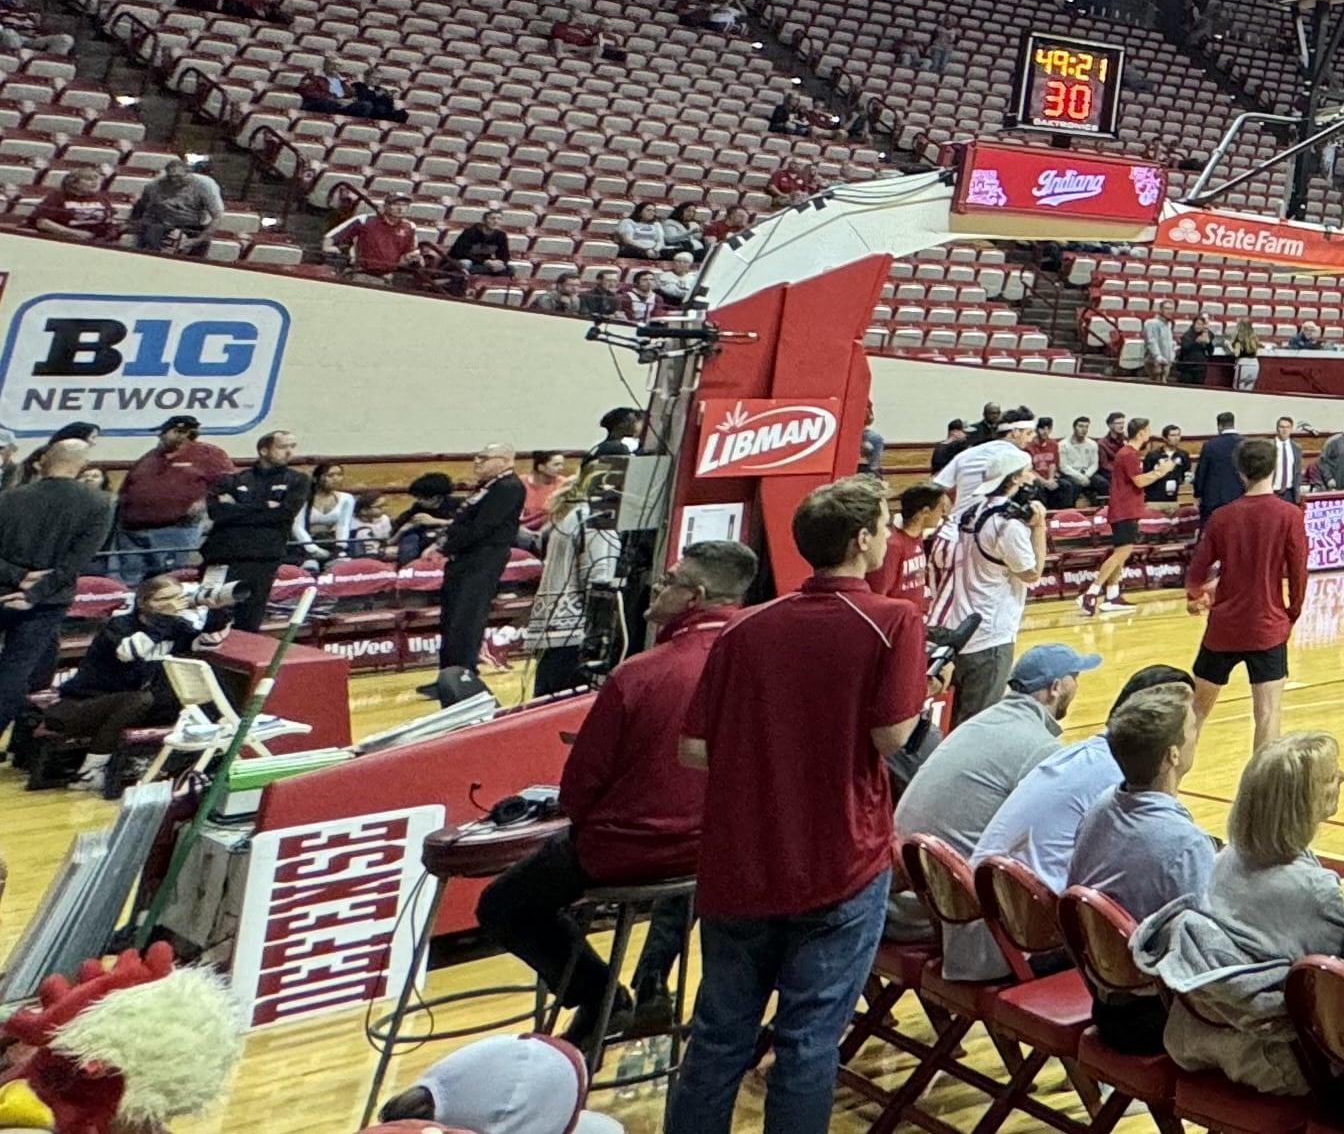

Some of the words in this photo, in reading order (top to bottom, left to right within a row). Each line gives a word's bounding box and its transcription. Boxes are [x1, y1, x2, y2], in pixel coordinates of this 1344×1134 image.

[1035, 48, 1108, 84] 49:21
[1043, 80, 1092, 120] 30
[1031, 169, 1106, 206] Indiana
[22, 387, 245, 411] NETWORK
[697, 417, 824, 475] LIBMAN
[249, 816, 410, 1028] DEFENSE
